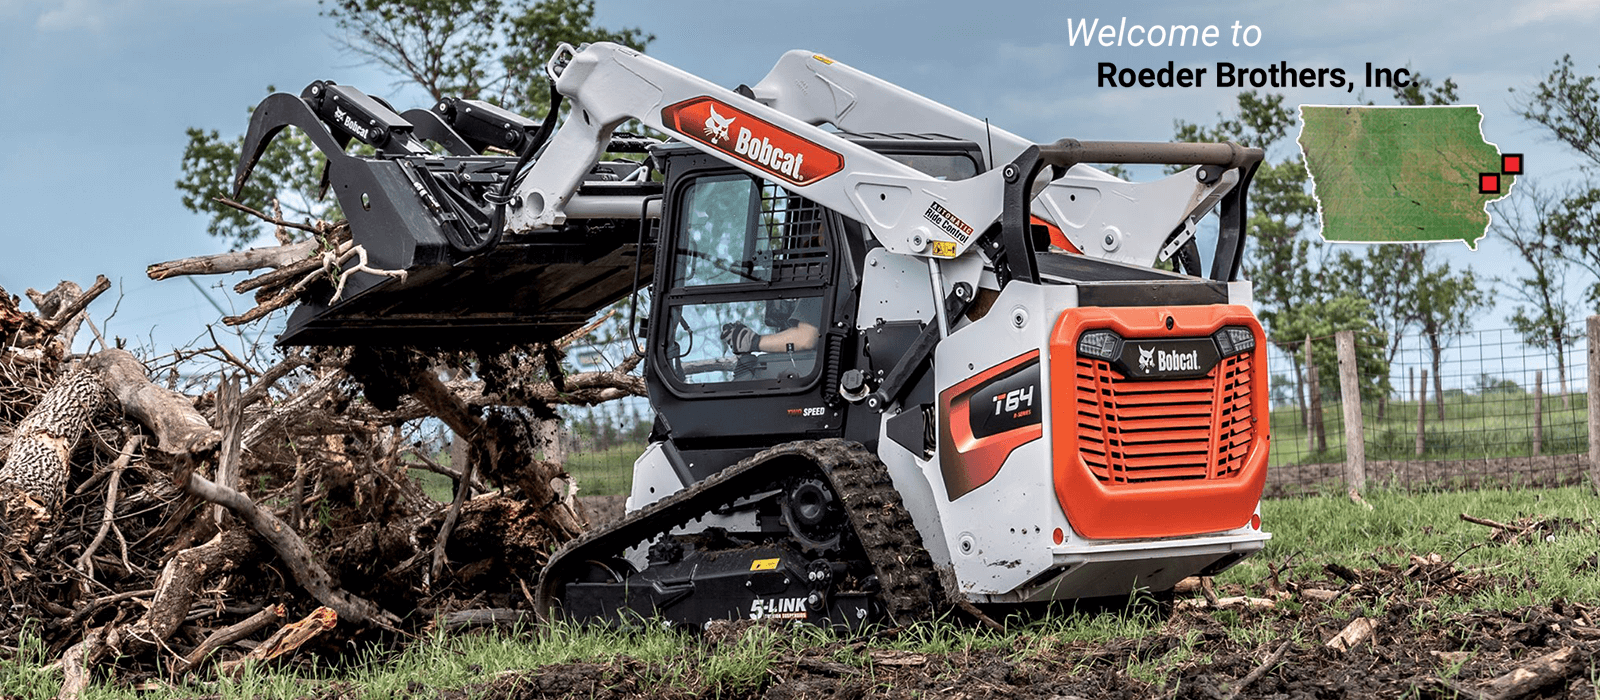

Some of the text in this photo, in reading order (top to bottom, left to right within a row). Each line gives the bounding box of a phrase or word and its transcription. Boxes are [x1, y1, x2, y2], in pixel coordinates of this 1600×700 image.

[344, 115, 369, 140] Bobcat
[734, 126, 804, 181] Bobcat
[924, 207, 970, 244] Ride Control
[932, 202, 972, 235] AUTOMATIC
[1158, 350, 1201, 371] Bobcat
[803, 406, 826, 417] SPEED
[992, 385, 1034, 416] T64
[749, 597, 808, 620] 5-LINK
